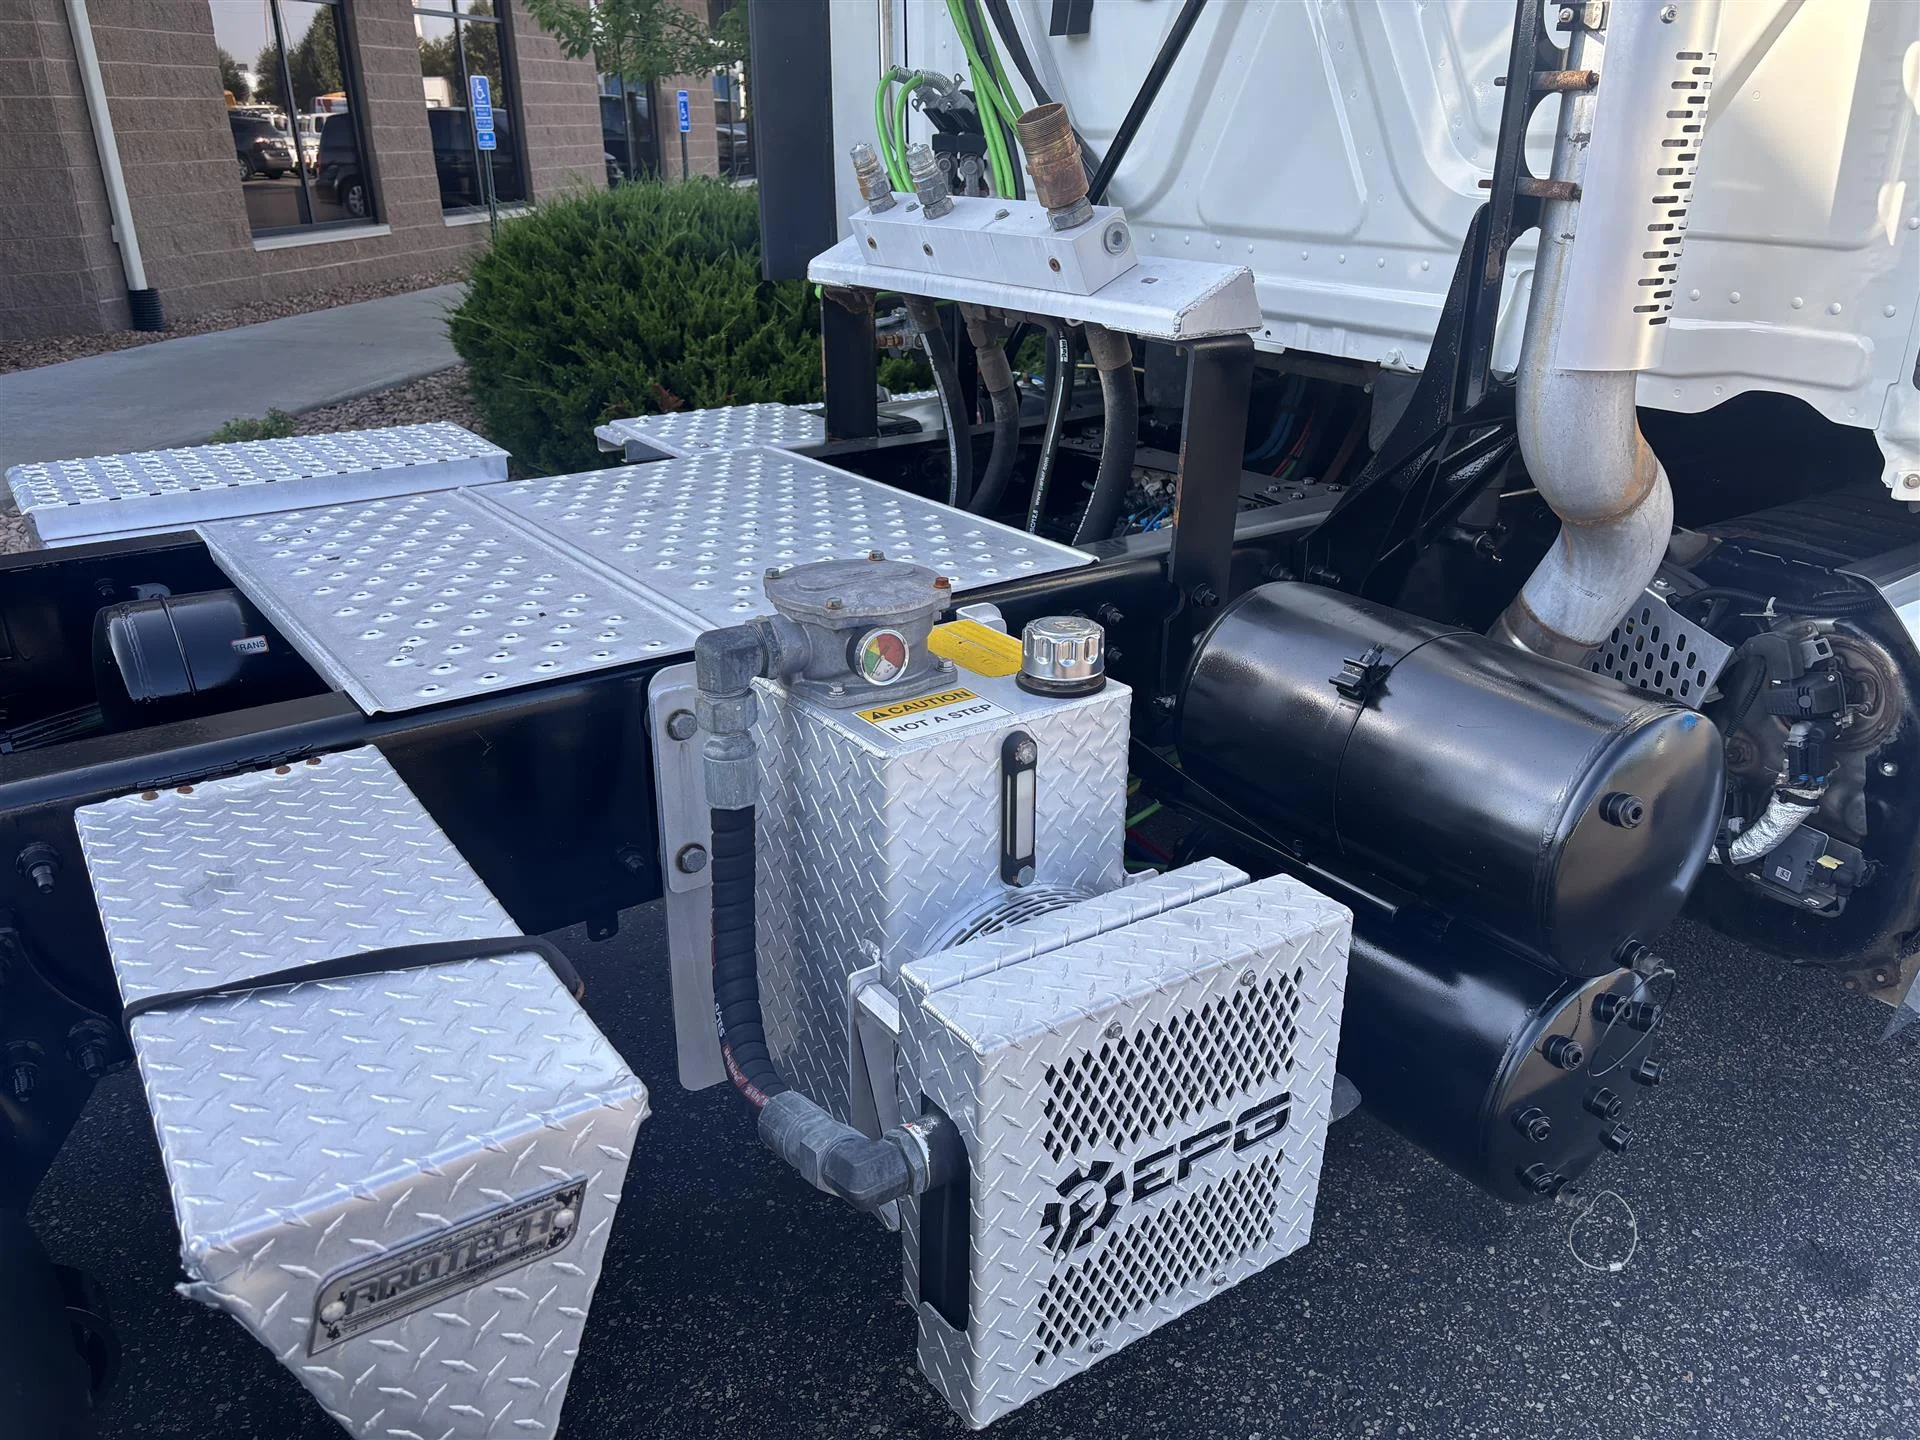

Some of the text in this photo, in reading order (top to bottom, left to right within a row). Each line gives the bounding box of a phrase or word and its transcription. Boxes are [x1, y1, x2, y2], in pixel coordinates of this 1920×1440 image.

[232, 640, 266, 653] TRANS
[887, 690, 971, 714] CAUTION
[889, 704, 992, 734] NOT A STEP
[1132, 1091, 1293, 1206] EPG
[344, 1209, 552, 1316] PROTECH
